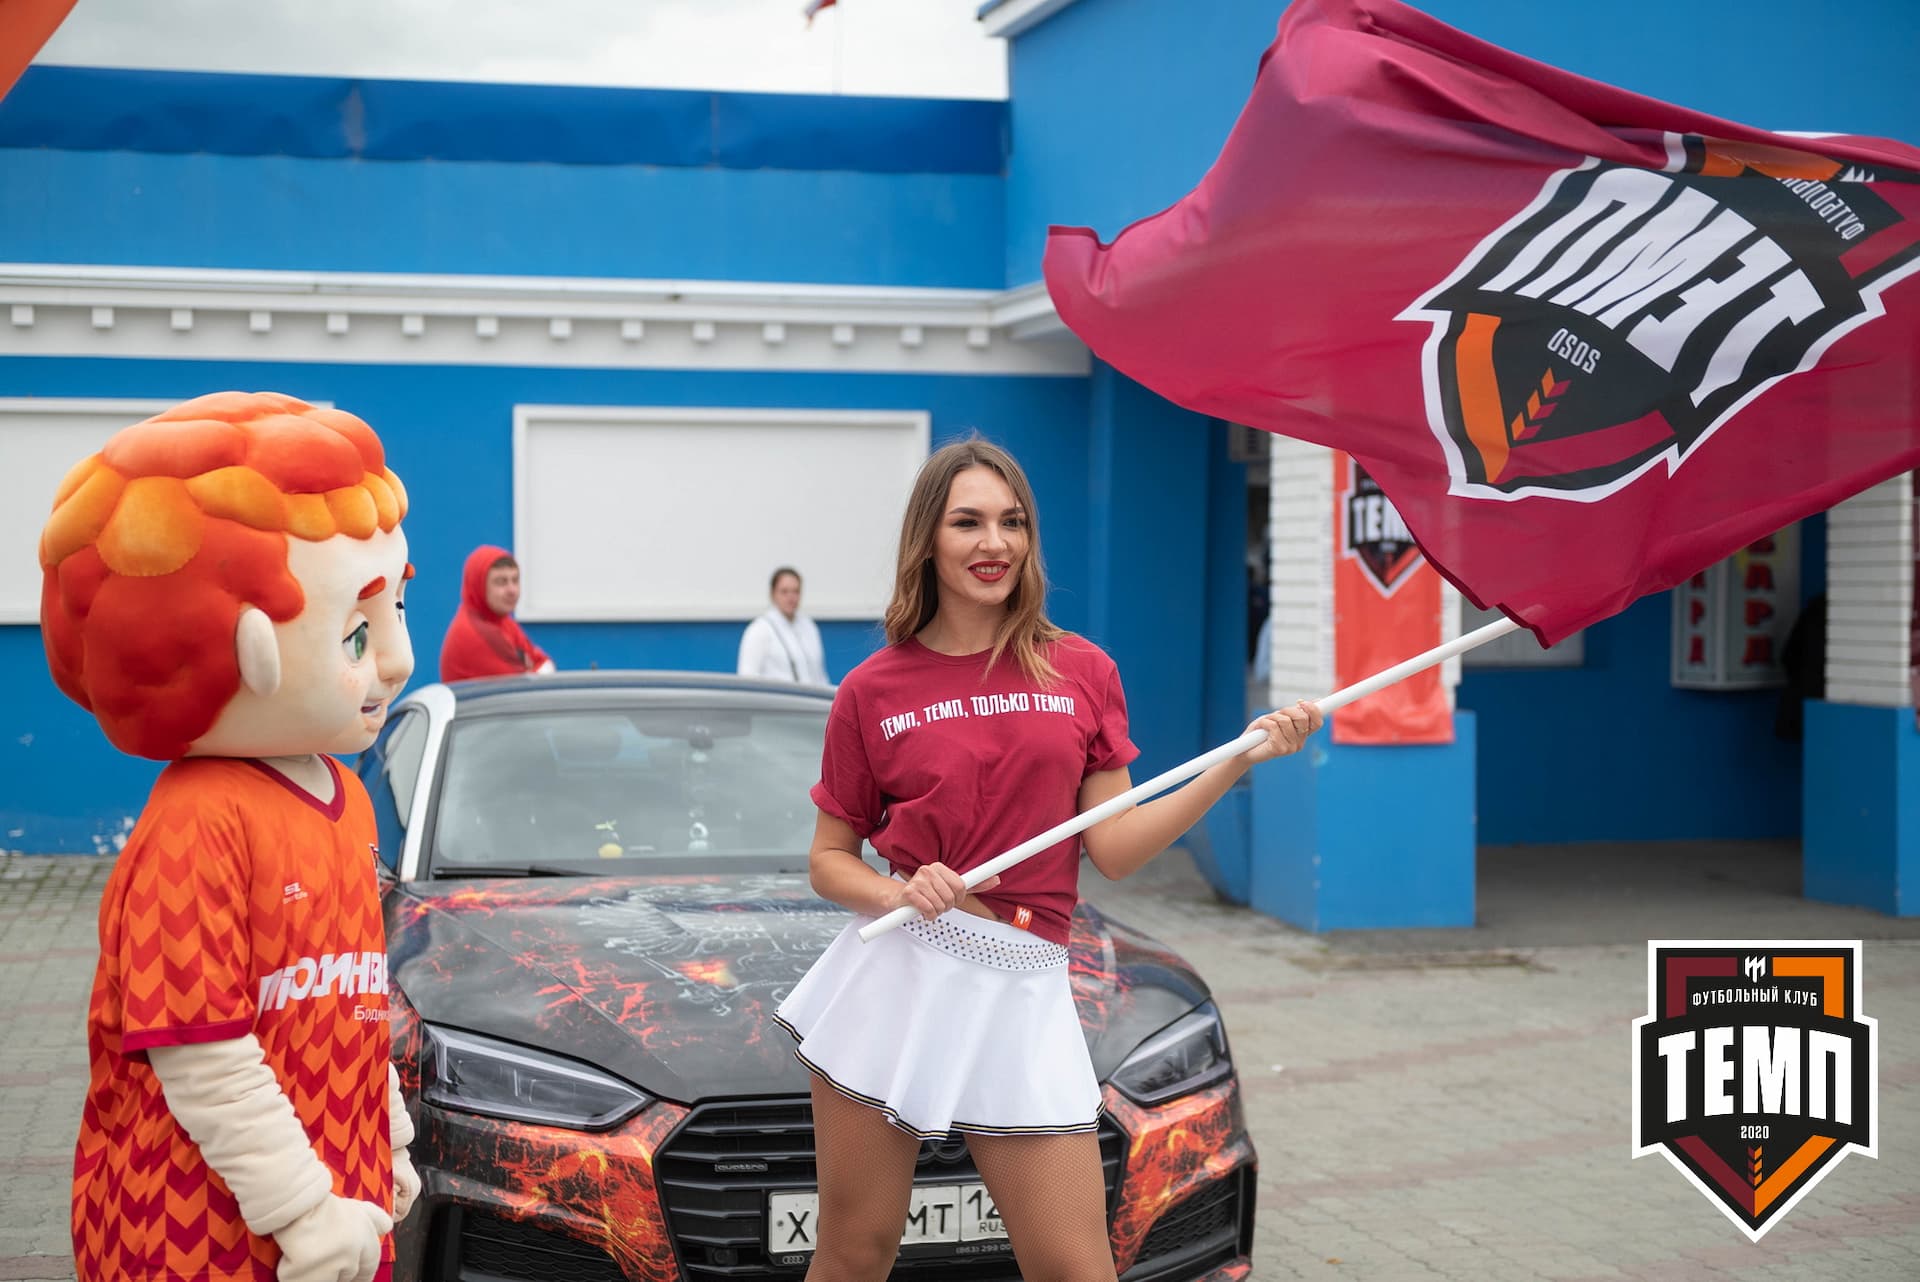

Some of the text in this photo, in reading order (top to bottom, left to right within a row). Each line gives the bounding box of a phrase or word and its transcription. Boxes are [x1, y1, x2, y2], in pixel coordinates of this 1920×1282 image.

[1352, 494, 1415, 544] ТЕМ
[880, 692, 1075, 741] ТЕМП, ТЕМП, ТОЛЬКО ТЕМП!
